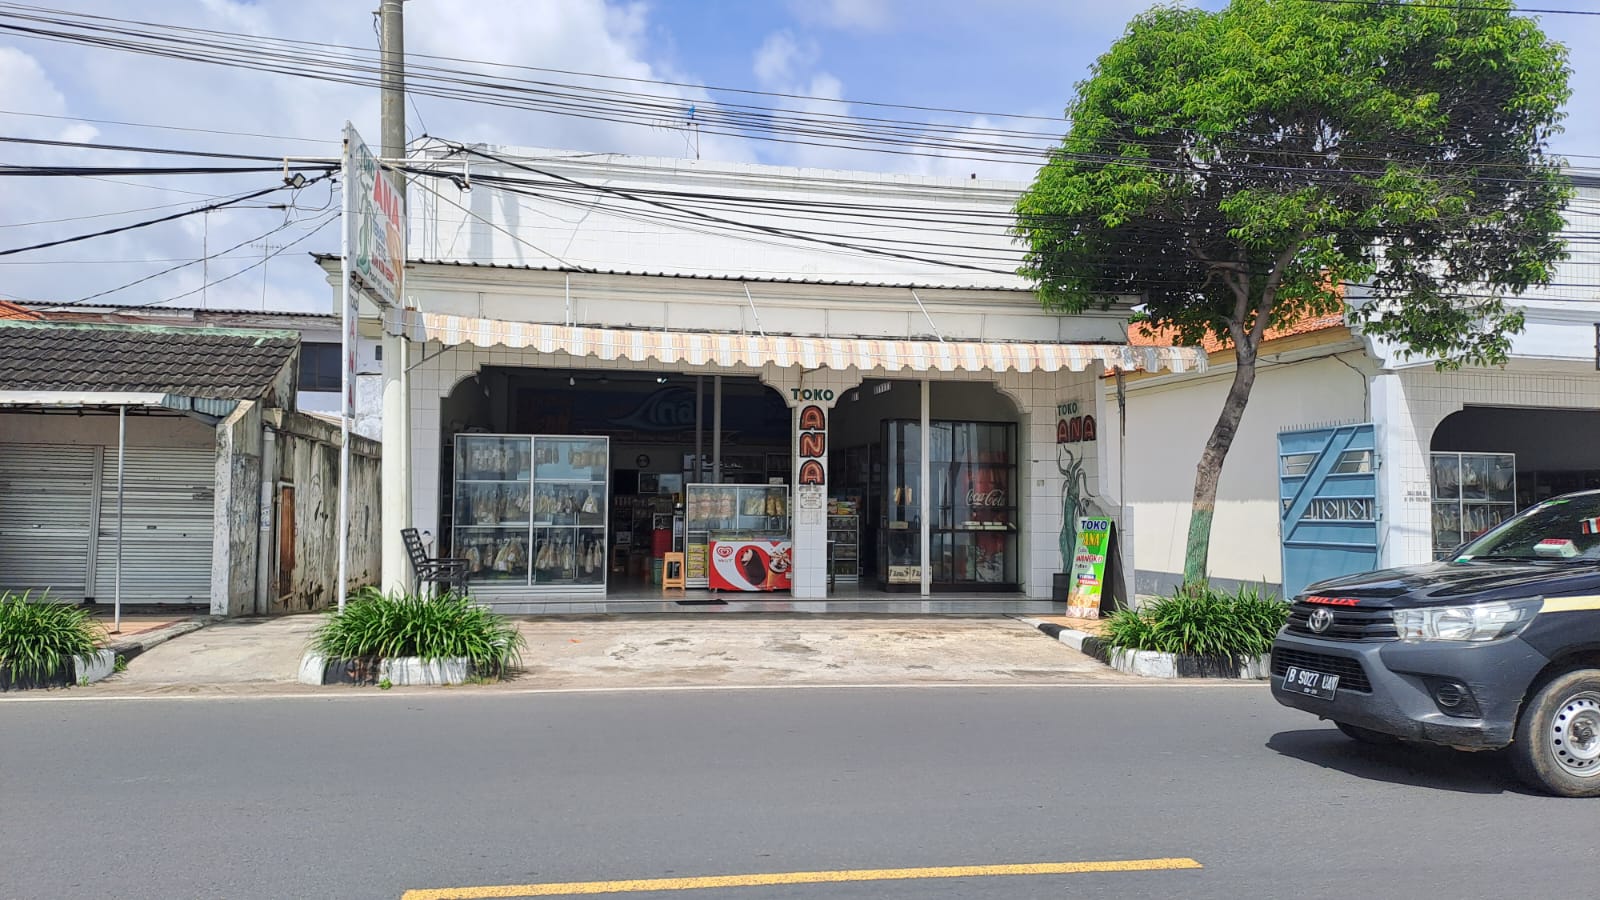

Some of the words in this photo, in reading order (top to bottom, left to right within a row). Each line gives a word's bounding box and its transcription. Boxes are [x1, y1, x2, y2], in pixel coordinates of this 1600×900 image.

[373, 169, 400, 232] ANA
[791, 388, 834, 401] TOKO
[1057, 402, 1078, 417] TOKO
[1057, 414, 1097, 444] ANA
[799, 405, 826, 486] ANA
[1081, 520, 1108, 530] TOKO
[1306, 595, 1360, 606] HILUX
[1288, 668, 1297, 683] B
